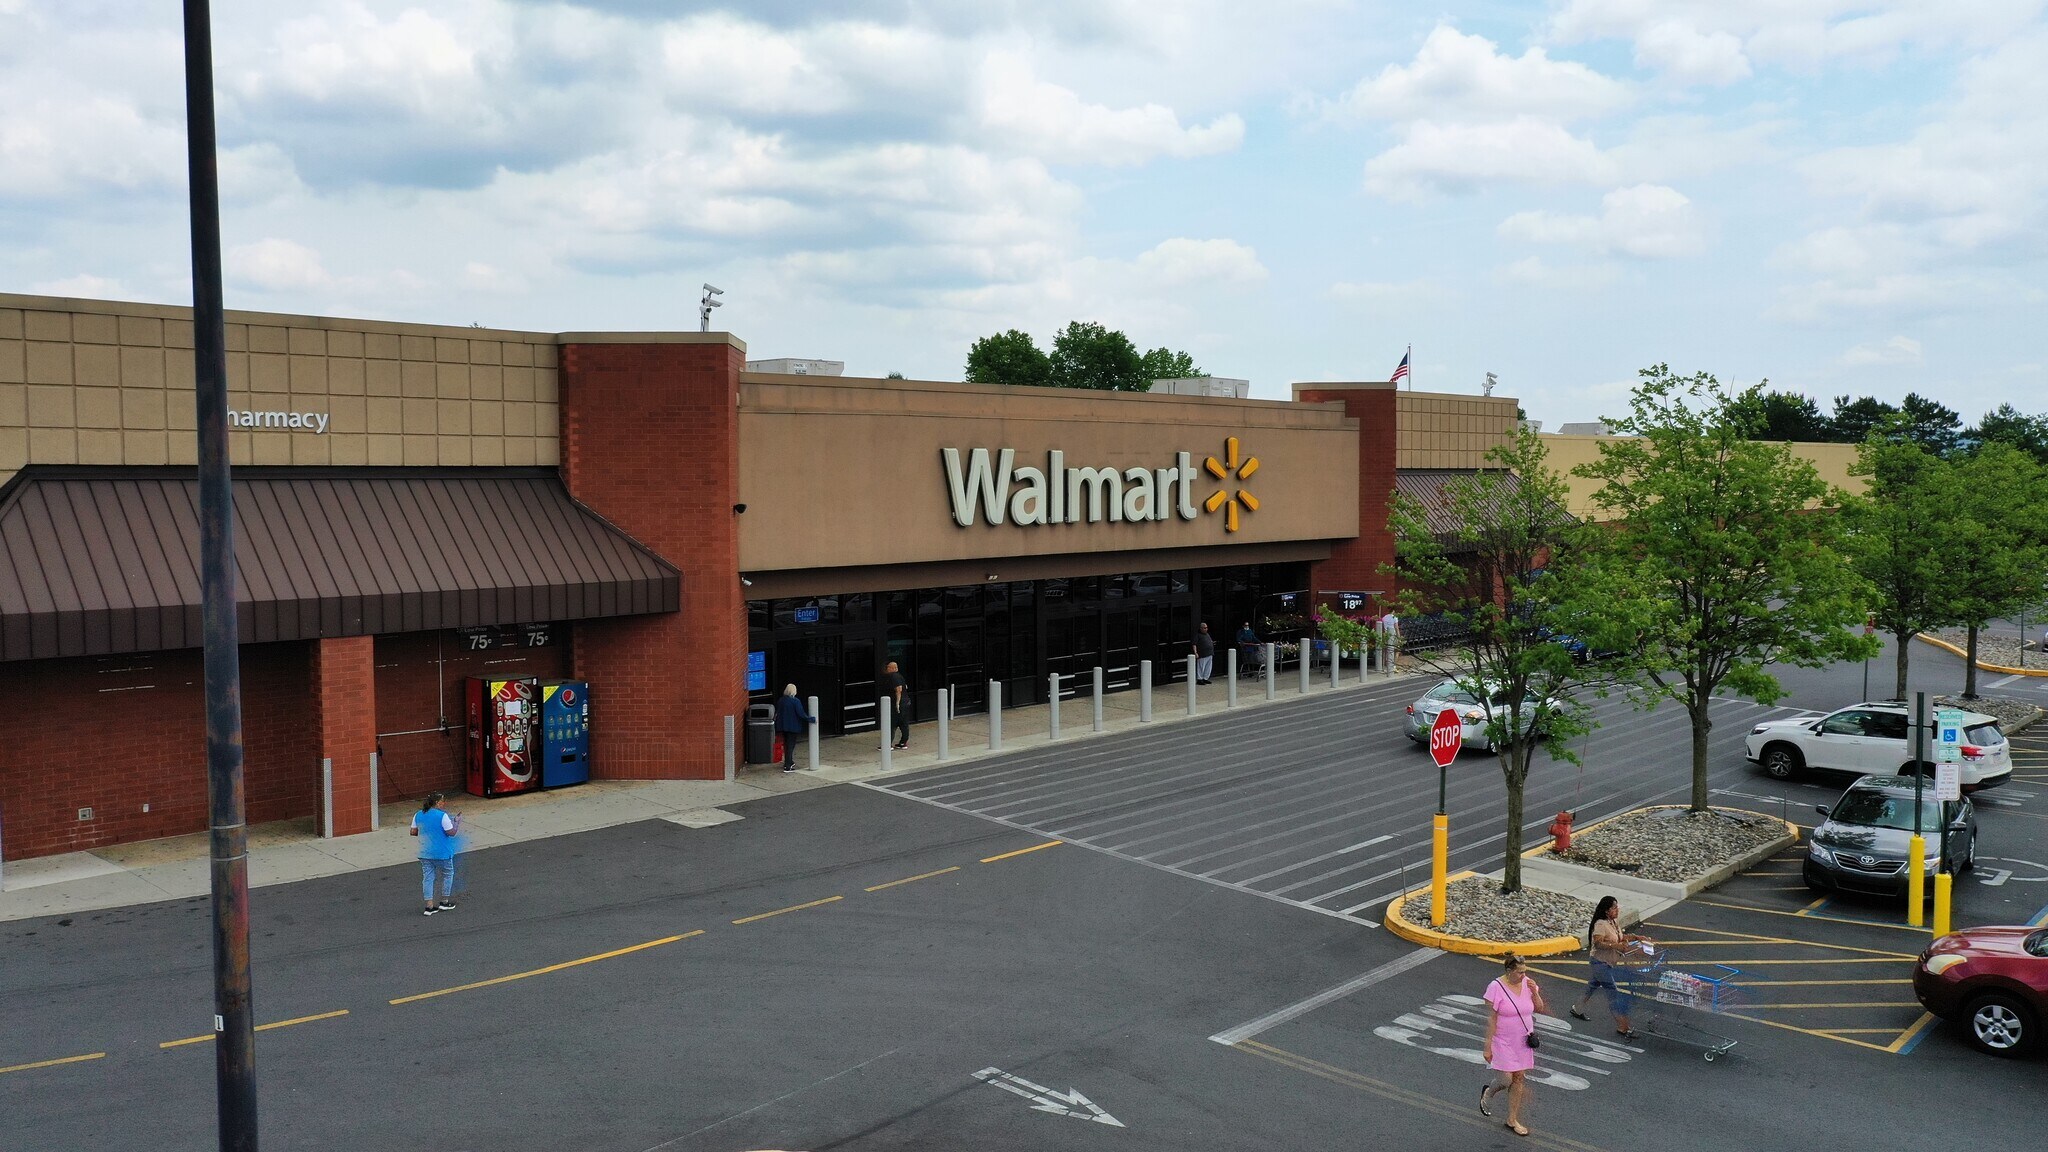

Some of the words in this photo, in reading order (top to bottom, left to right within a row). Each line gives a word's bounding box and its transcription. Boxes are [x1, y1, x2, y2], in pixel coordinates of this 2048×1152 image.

[227, 405, 328, 434] harmacy
[940, 447, 1198, 527] Walmart
[797, 609, 816, 617] Enter
[1432, 724, 1460, 750] STOP
[1373, 994, 1645, 1091] STOP
